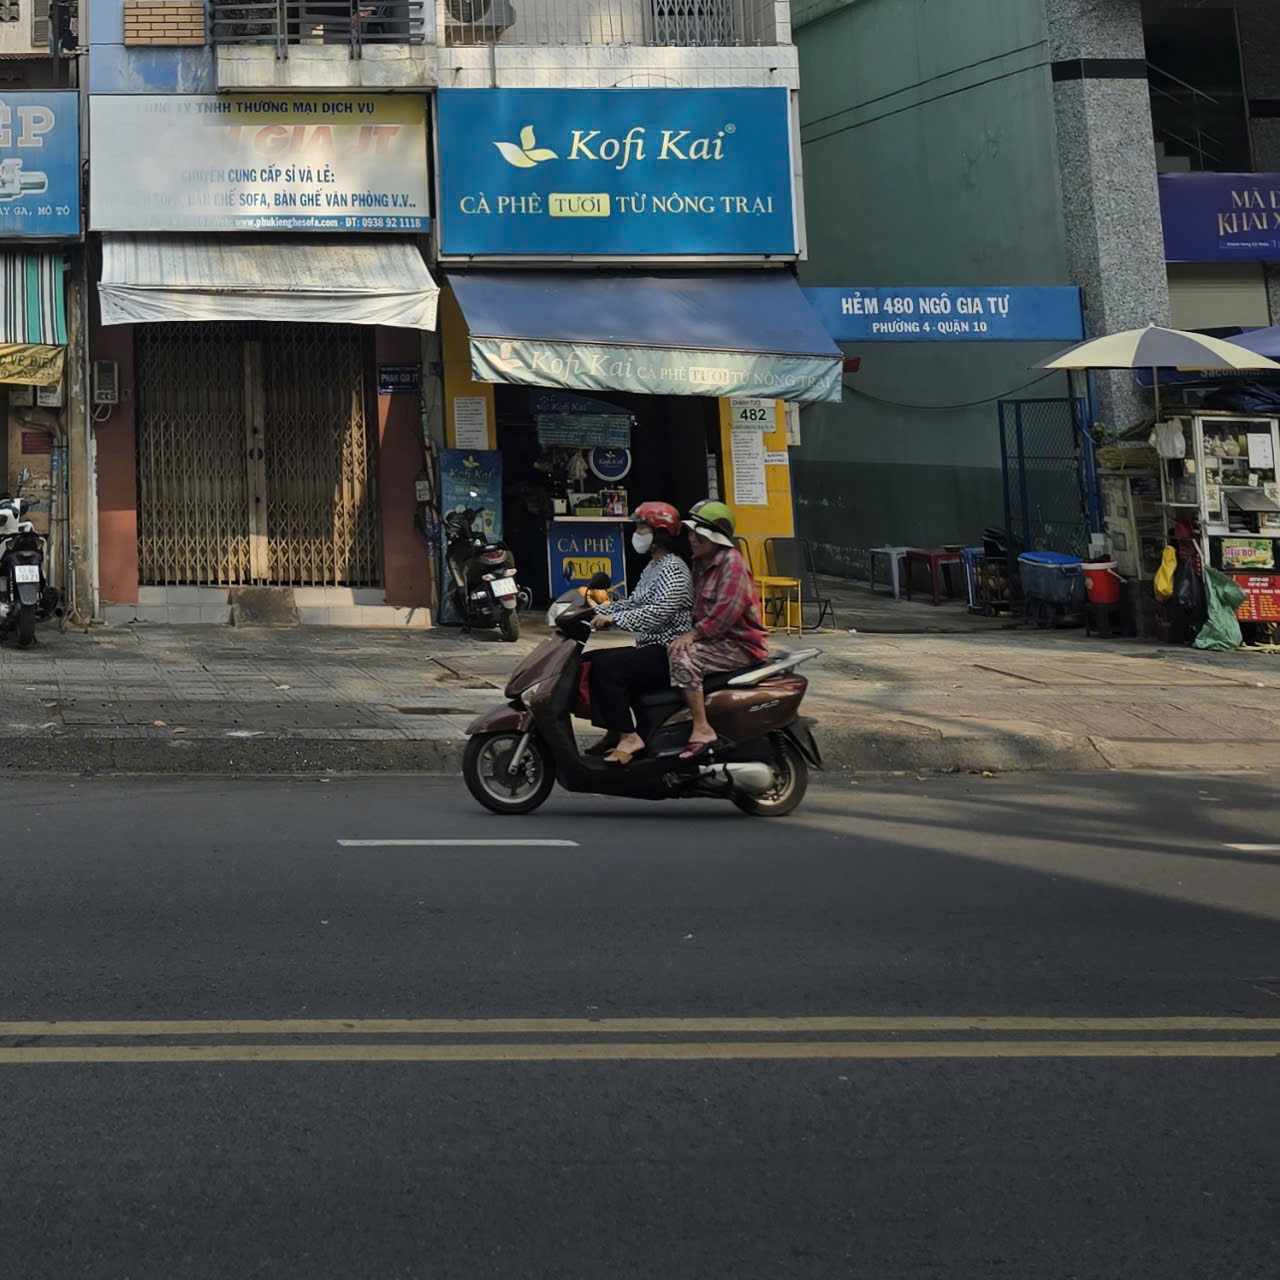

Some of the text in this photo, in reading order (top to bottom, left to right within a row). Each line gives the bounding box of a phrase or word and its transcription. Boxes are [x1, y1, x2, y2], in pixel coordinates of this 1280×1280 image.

[196, 102, 232, 113] TNHH
[236, 101, 289, 113] THƯƠNG
[293, 102, 318, 115] MẠI
[322, 102, 353, 115] DỊCH
[357, 102, 376, 116] VỤ
[254, 125, 336, 154] GIA
[567, 126, 646, 170] Kofi
[228, 168, 257, 183] CUNG
[260, 163, 282, 183] CẤP
[298, 164, 313, 183] VÀ
[239, 193, 271, 208] SOFA,
[274, 190, 296, 207] BÀN
[299, 188, 322, 207] GHẾ
[326, 190, 348, 207] VĂN
[351, 190, 389, 207] PHÒNG
[459, 191, 773, 217] CÀ PHÊ TƯƠI TỪ NÔNG TRẠI
[1231, 187, 1266, 209] MÃ
[13, 206, 33, 217] GA,
[37, 204, 53, 216] MÔ
[56, 204, 70, 216] TÔ
[235, 216, 338, 228] www.phukienghesofa.com
[362, 216, 384, 227] 0938
[385, 216, 397, 227] 92
[399, 216, 422, 227] 1118
[1216, 212, 1269, 236] KHAI
[841, 291, 1010, 318] HẺM 480 NGÔ GIA TỰ
[872, 318, 988, 335] PHƯỜNG 4 QUẬN 10
[531, 351, 581, 381] Kofi
[589, 353, 633, 378] Kai
[660, 366, 688, 382] PHÊ
[740, 408, 767, 421] 482
[557, 534, 615, 553] CÀ PHÊ
